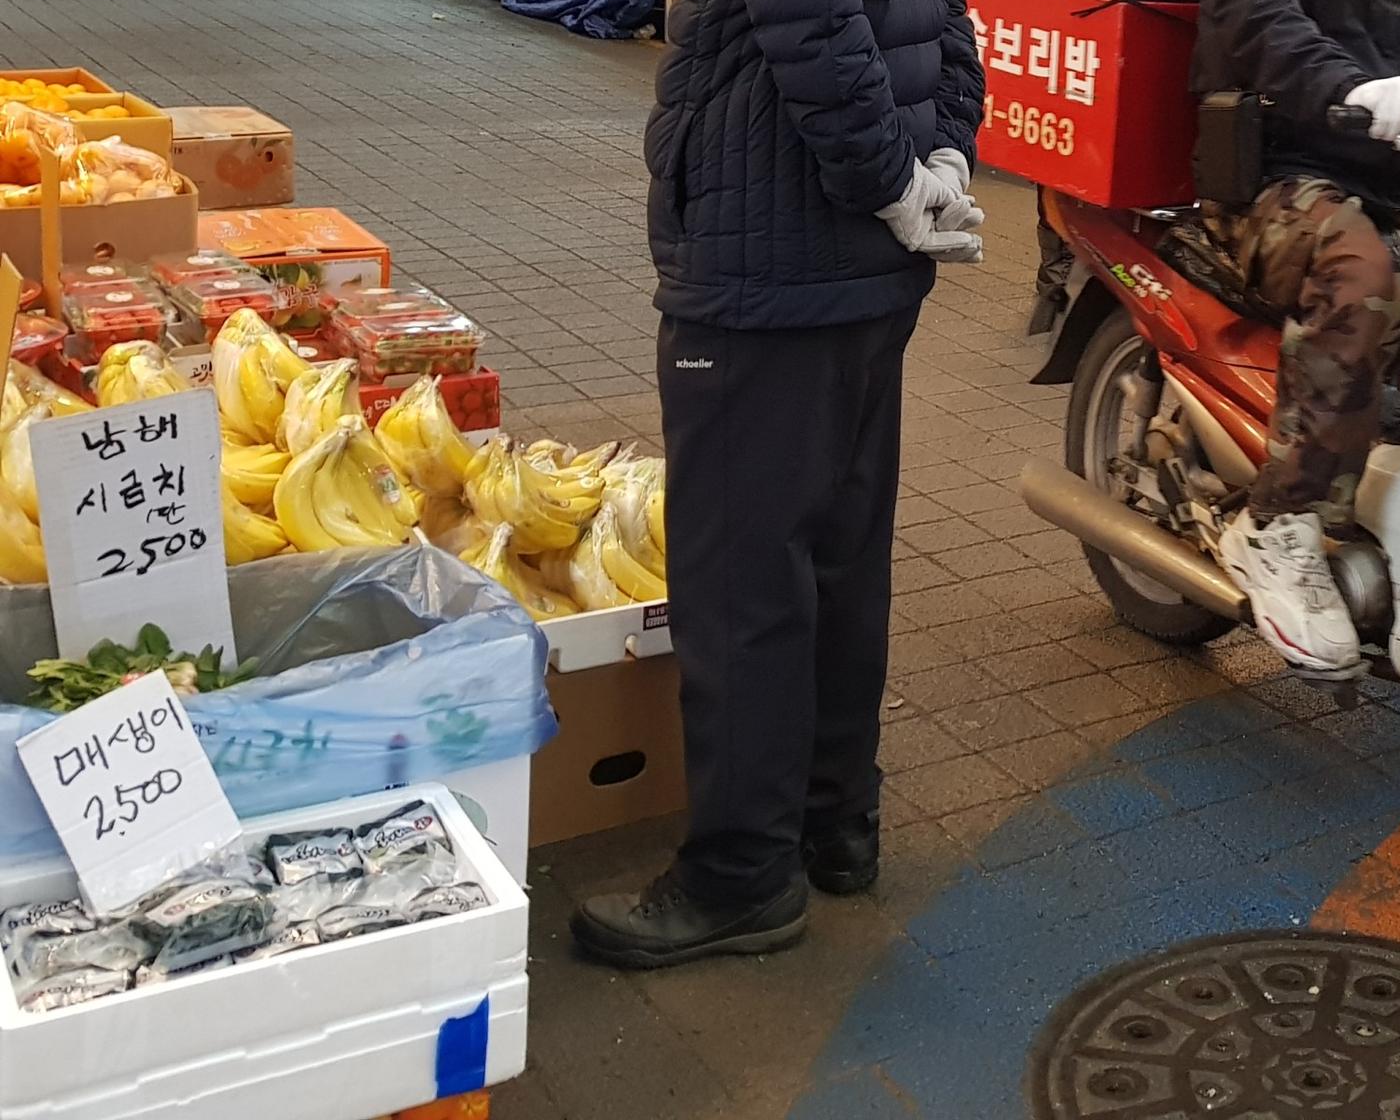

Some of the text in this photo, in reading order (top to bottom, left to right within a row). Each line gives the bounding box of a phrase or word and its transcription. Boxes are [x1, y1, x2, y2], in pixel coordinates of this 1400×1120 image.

[676, 358, 713, 369] schoeller
[83, 413, 178, 461] 남해
[77, 463, 186, 516] 시금치
[53, 697, 184, 786] 매생이
